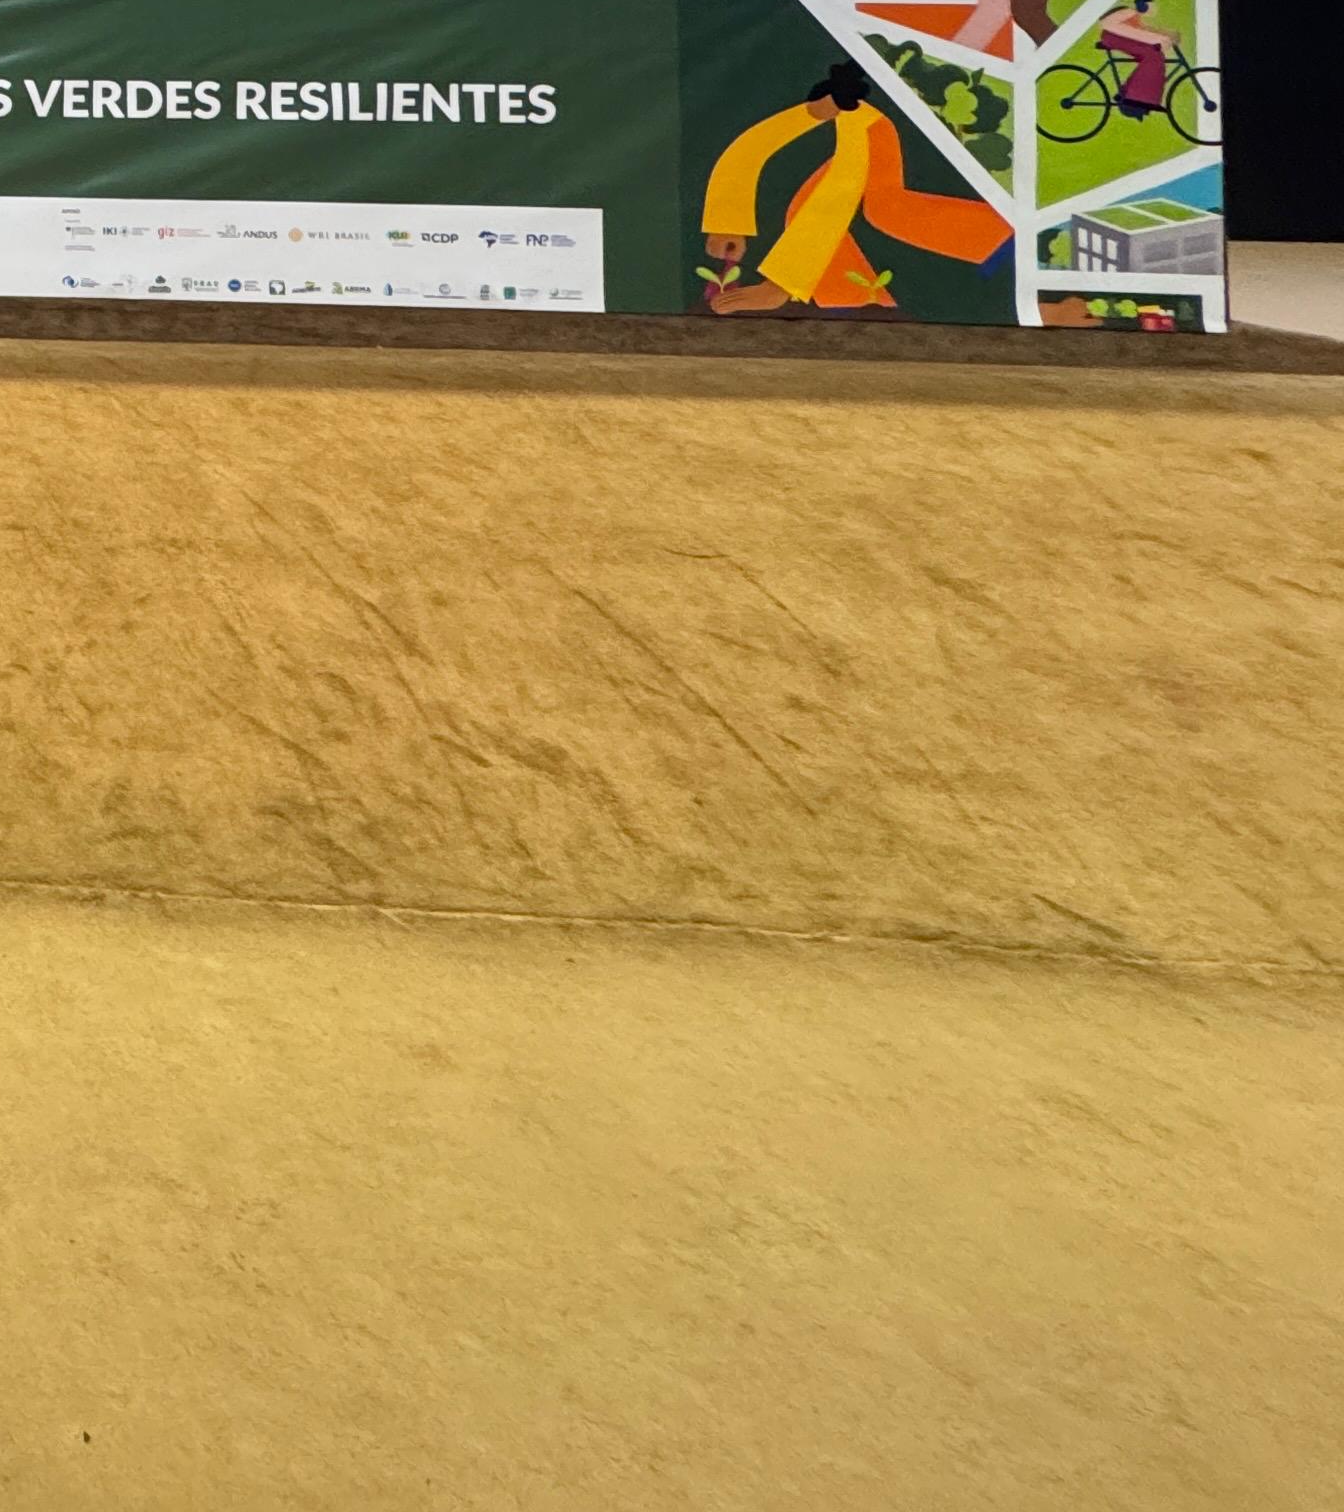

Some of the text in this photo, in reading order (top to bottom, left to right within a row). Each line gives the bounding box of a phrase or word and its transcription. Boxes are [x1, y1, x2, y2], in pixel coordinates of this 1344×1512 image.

[23, 79, 221, 120] VERDES
[236, 81, 557, 125] RESILIENTES
[102, 226, 117, 236] IKI
[157, 225, 175, 240] giz
[243, 230, 278, 239] ANDUS
[431, 233, 459, 244] CDP
